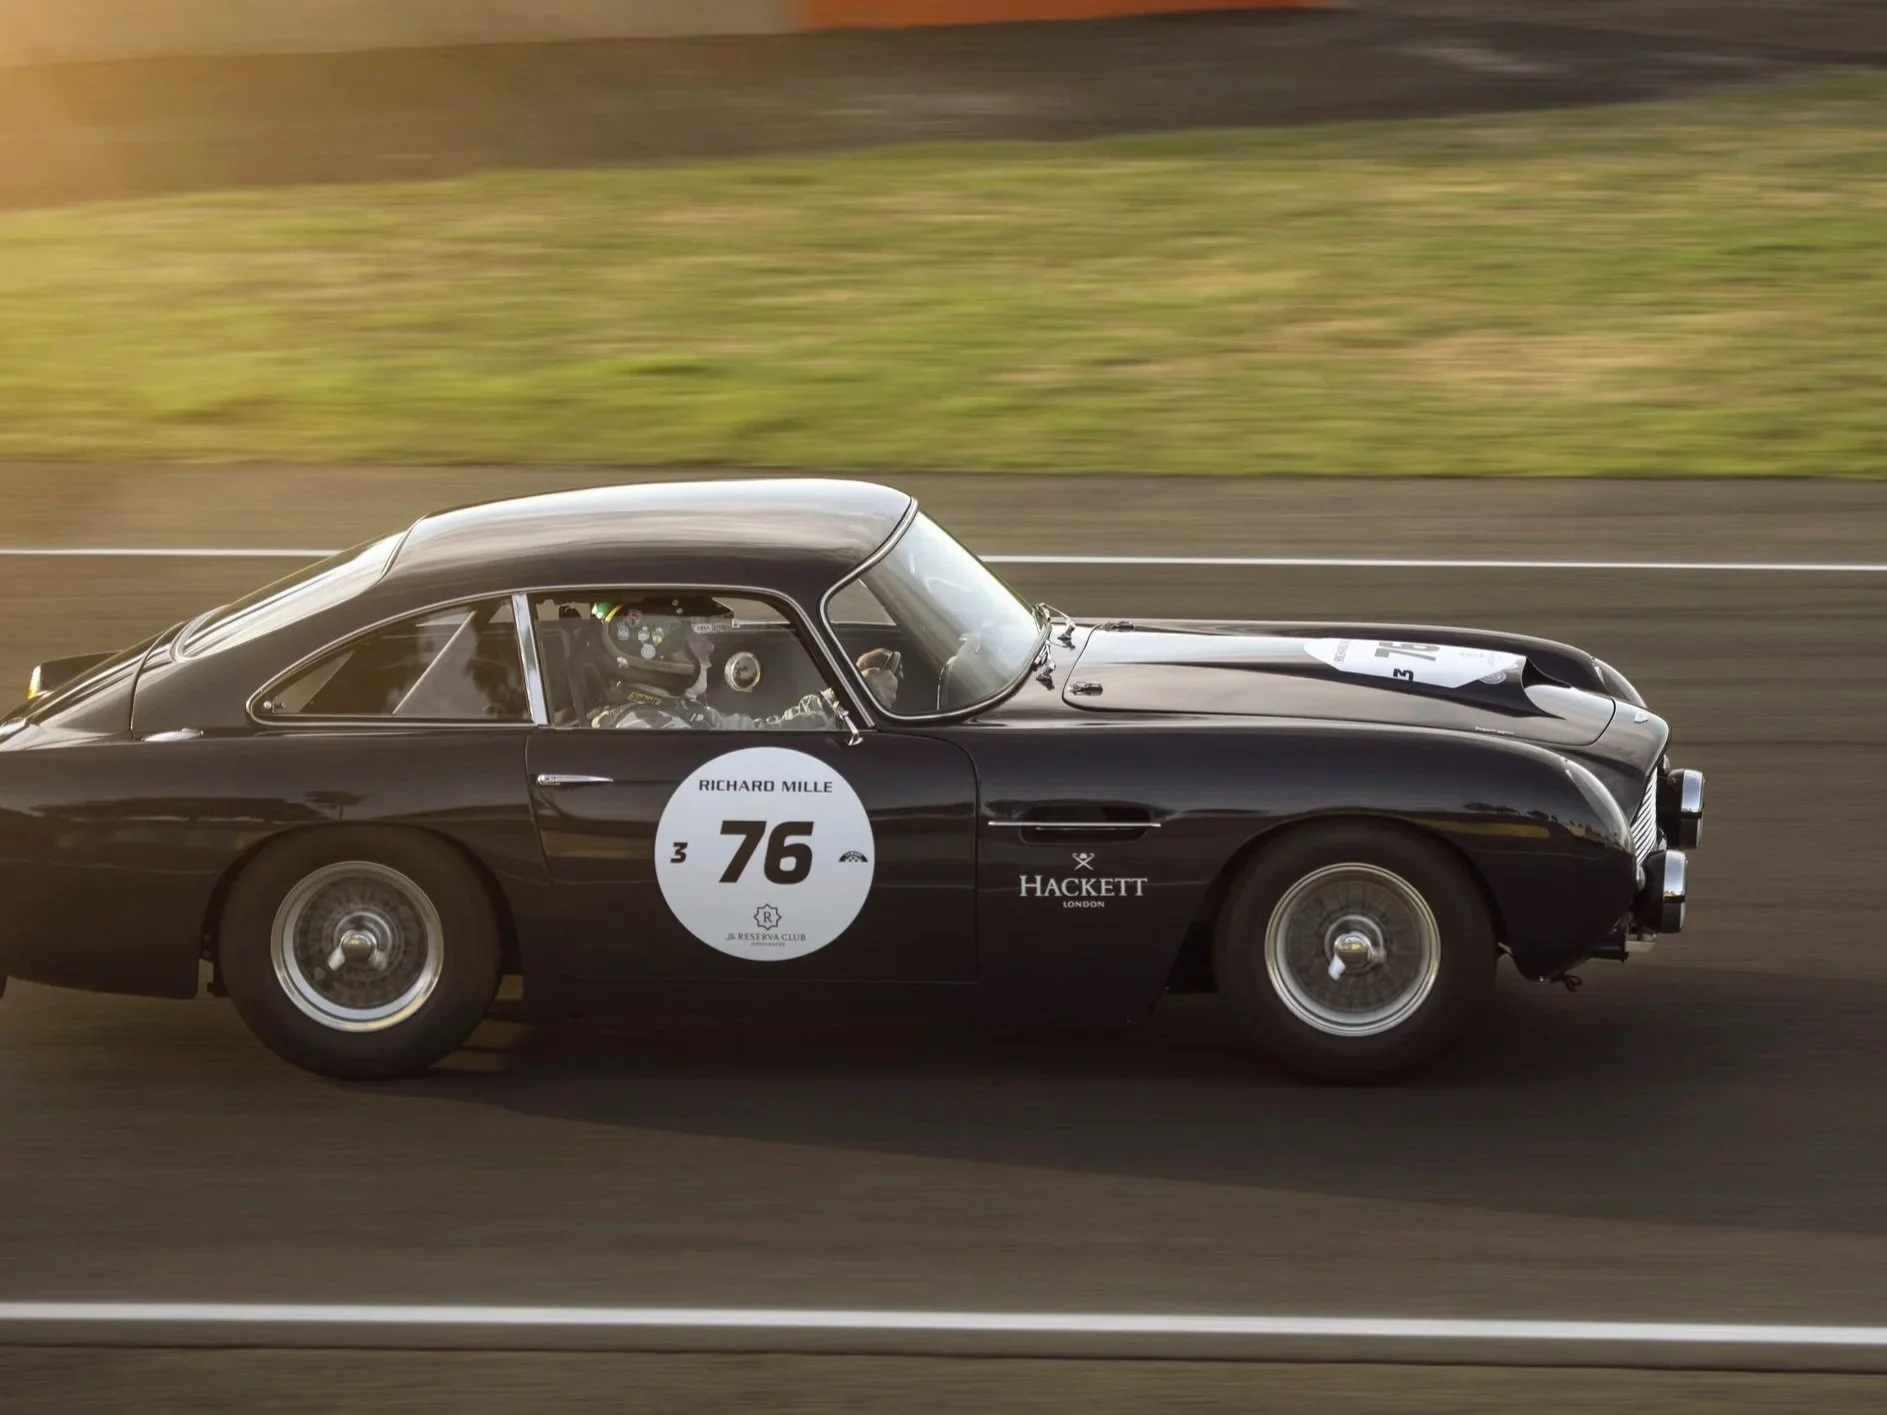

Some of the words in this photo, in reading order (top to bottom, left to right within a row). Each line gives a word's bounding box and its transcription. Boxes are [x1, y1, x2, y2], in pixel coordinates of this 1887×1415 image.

[1393, 668, 1414, 682] 3
[699, 779, 775, 793] RICHARD
[781, 780, 833, 793] MILLE
[670, 842, 688, 863] 3
[718, 820, 814, 885] 76
[762, 911, 773, 923] R
[738, 932, 780, 942] RESERVA
[781, 933, 807, 942] CLUB
